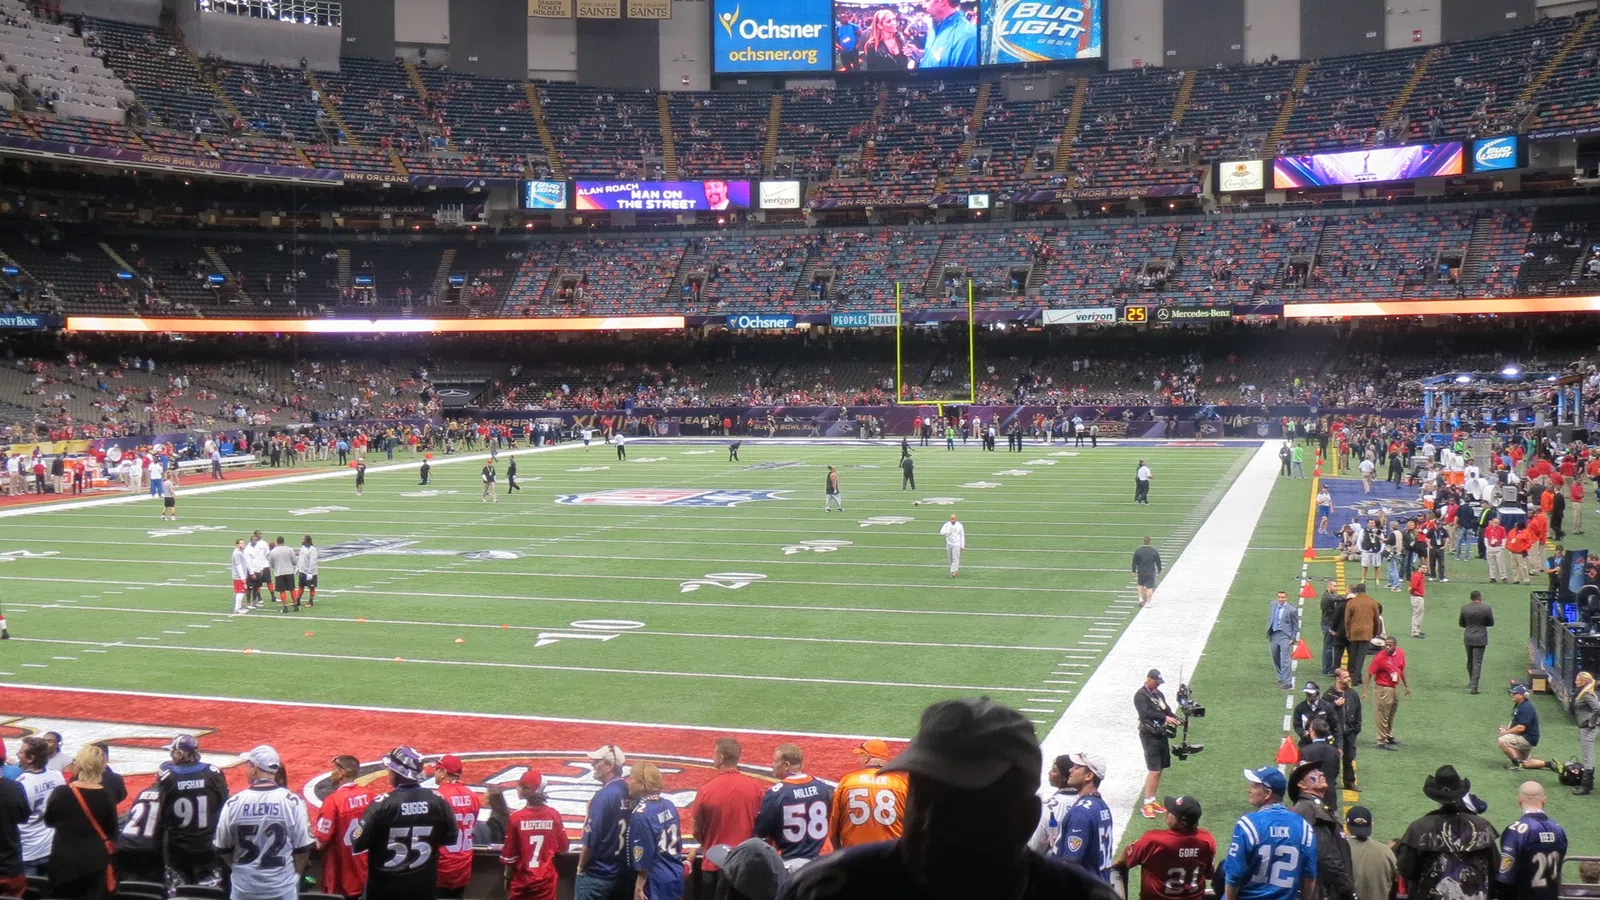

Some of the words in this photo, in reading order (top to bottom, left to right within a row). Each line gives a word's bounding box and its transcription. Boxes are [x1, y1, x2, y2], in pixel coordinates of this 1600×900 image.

[580, 7, 617, 16] SAINTS
[630, 7, 667, 16] SAINTS
[1012, 2, 1084, 22] BUD
[739, 19, 822, 39] Ochsner
[1000, 20, 1085, 38] LIGHT
[729, 46, 817, 64] ochsner.org
[1481, 151, 1513, 160] LIGHT
[1486, 146, 1511, 154] BUD
[141, 154, 171, 162] SUPER
[172, 157, 197, 166] BOWL
[199, 160, 220, 169] XLVII
[343, 172, 364, 180] NEW
[366, 173, 409, 183] ORLEANS
[577, 187, 604, 196] ALAN
[605, 183, 639, 193] ROACH
[631, 190, 659, 200] MAN
[662, 190, 683, 199] ON
[617, 200, 643, 209] THE
[645, 200, 697, 209] STREET
[763, 196, 795, 206] verizon
[833, 315, 868, 325] PEOPLES
[870, 315, 900, 325] HEALT
[1076, 312, 1113, 322] verizon
[1127, 308, 1145, 321] 25
[1171, 309, 1231, 318] Mercedes-Benz
[16, 316, 37, 326] BANK
[738, 315, 788, 328] Ochsner
[679, 572, 768, 591] 20
[537, 619, 646, 642] 10
[177, 779, 205, 791] UPSHAW
[793, 786, 818, 799] MILLER
[348, 794, 369, 809] LOTT
[848, 788, 897, 825] 58
[173, 796, 208, 829] 91
[243, 803, 280, 816] R.LEWIS
[401, 801, 429, 816] SUGGS
[122, 801, 160, 837] 21
[782, 801, 828, 842] 58
[1269, 826, 1290, 838] LUCK
[1508, 820, 1529, 834] 20
[236, 823, 286, 868] 52
[384, 826, 434, 869] 55
[529, 835, 544, 868] 7
[1178, 848, 1199, 858] GORE
[1251, 844, 1299, 889] 12
